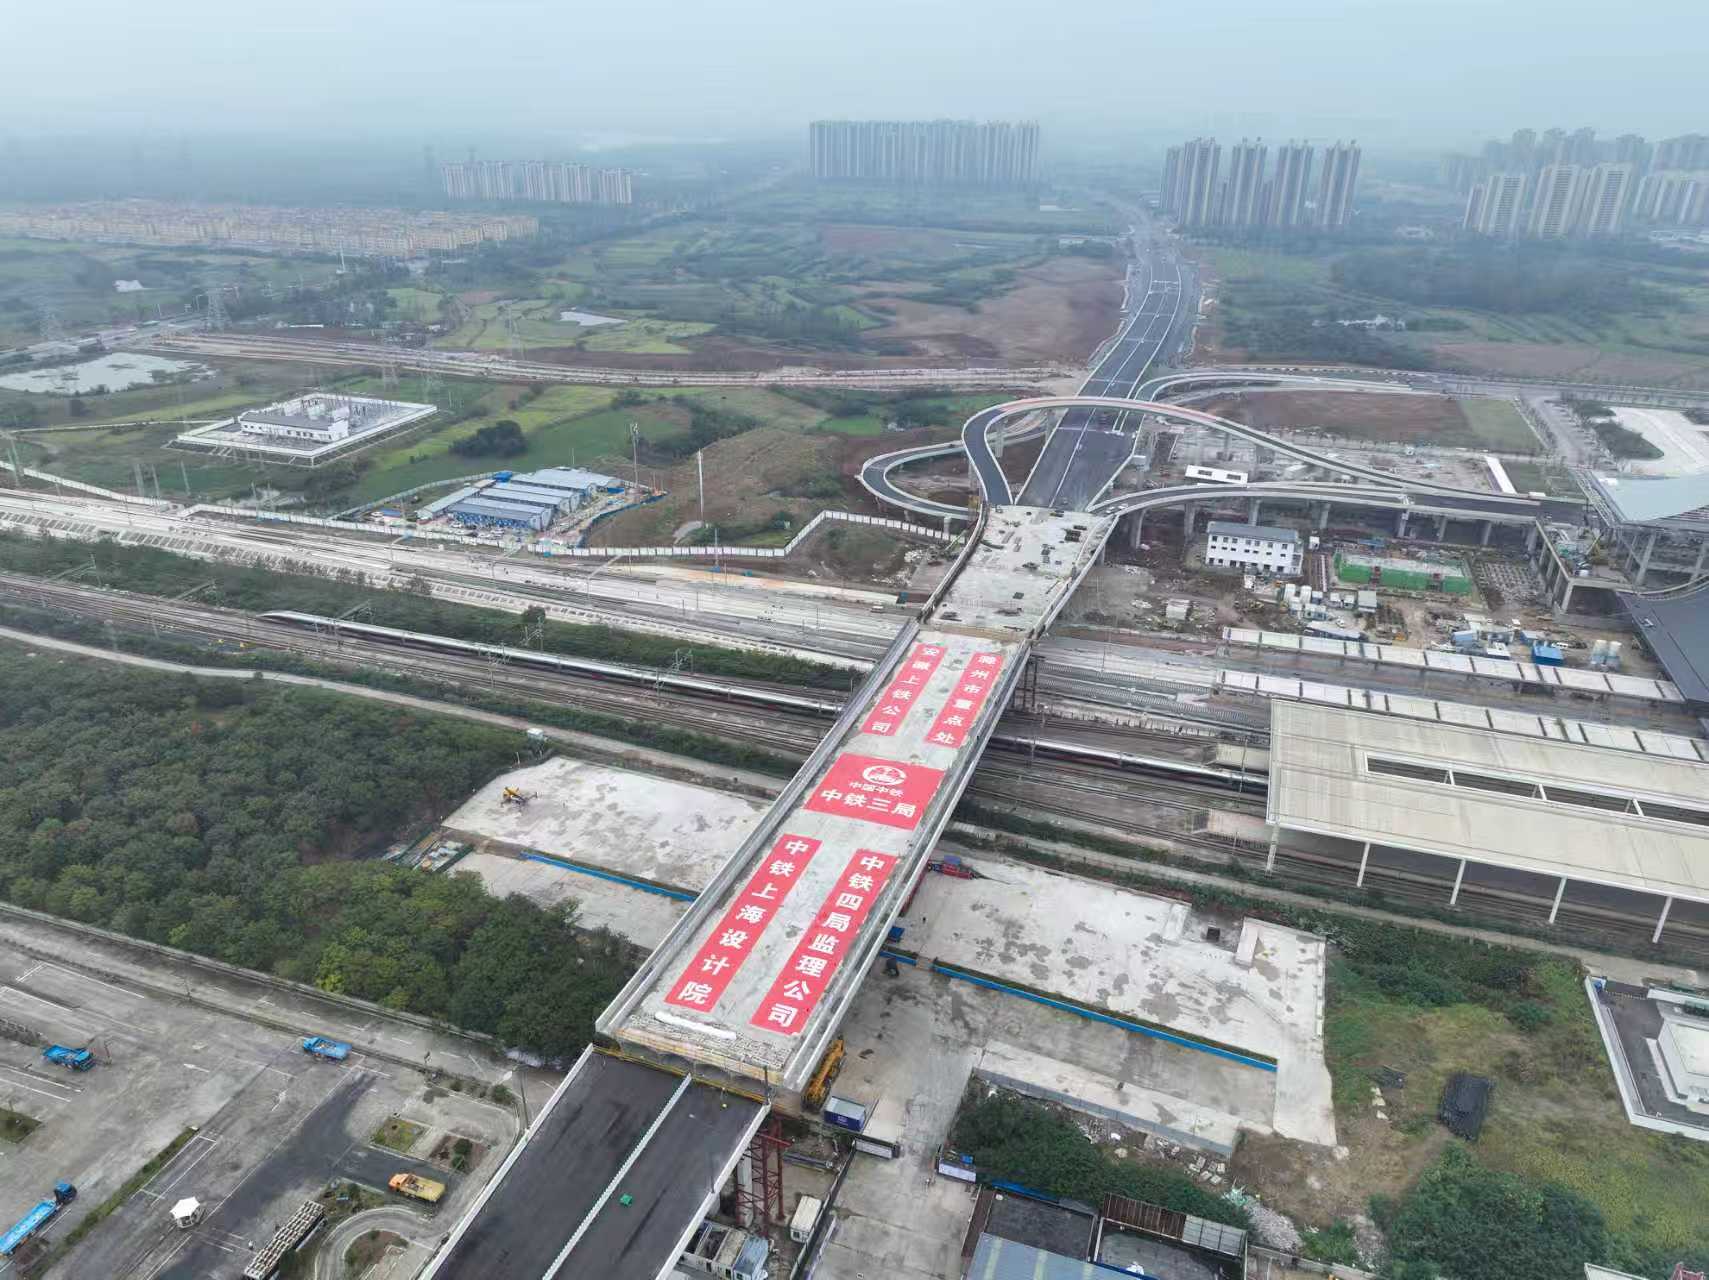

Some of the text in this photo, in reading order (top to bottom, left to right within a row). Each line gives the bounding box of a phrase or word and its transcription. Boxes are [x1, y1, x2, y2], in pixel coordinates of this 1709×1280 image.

[820, 788, 917, 818] 中铁三局
[848, 781, 904, 798] 中国中铁
[677, 840, 810, 1006] 中铁上海设计院
[768, 856, 885, 1028] 中铁四局监理公司
